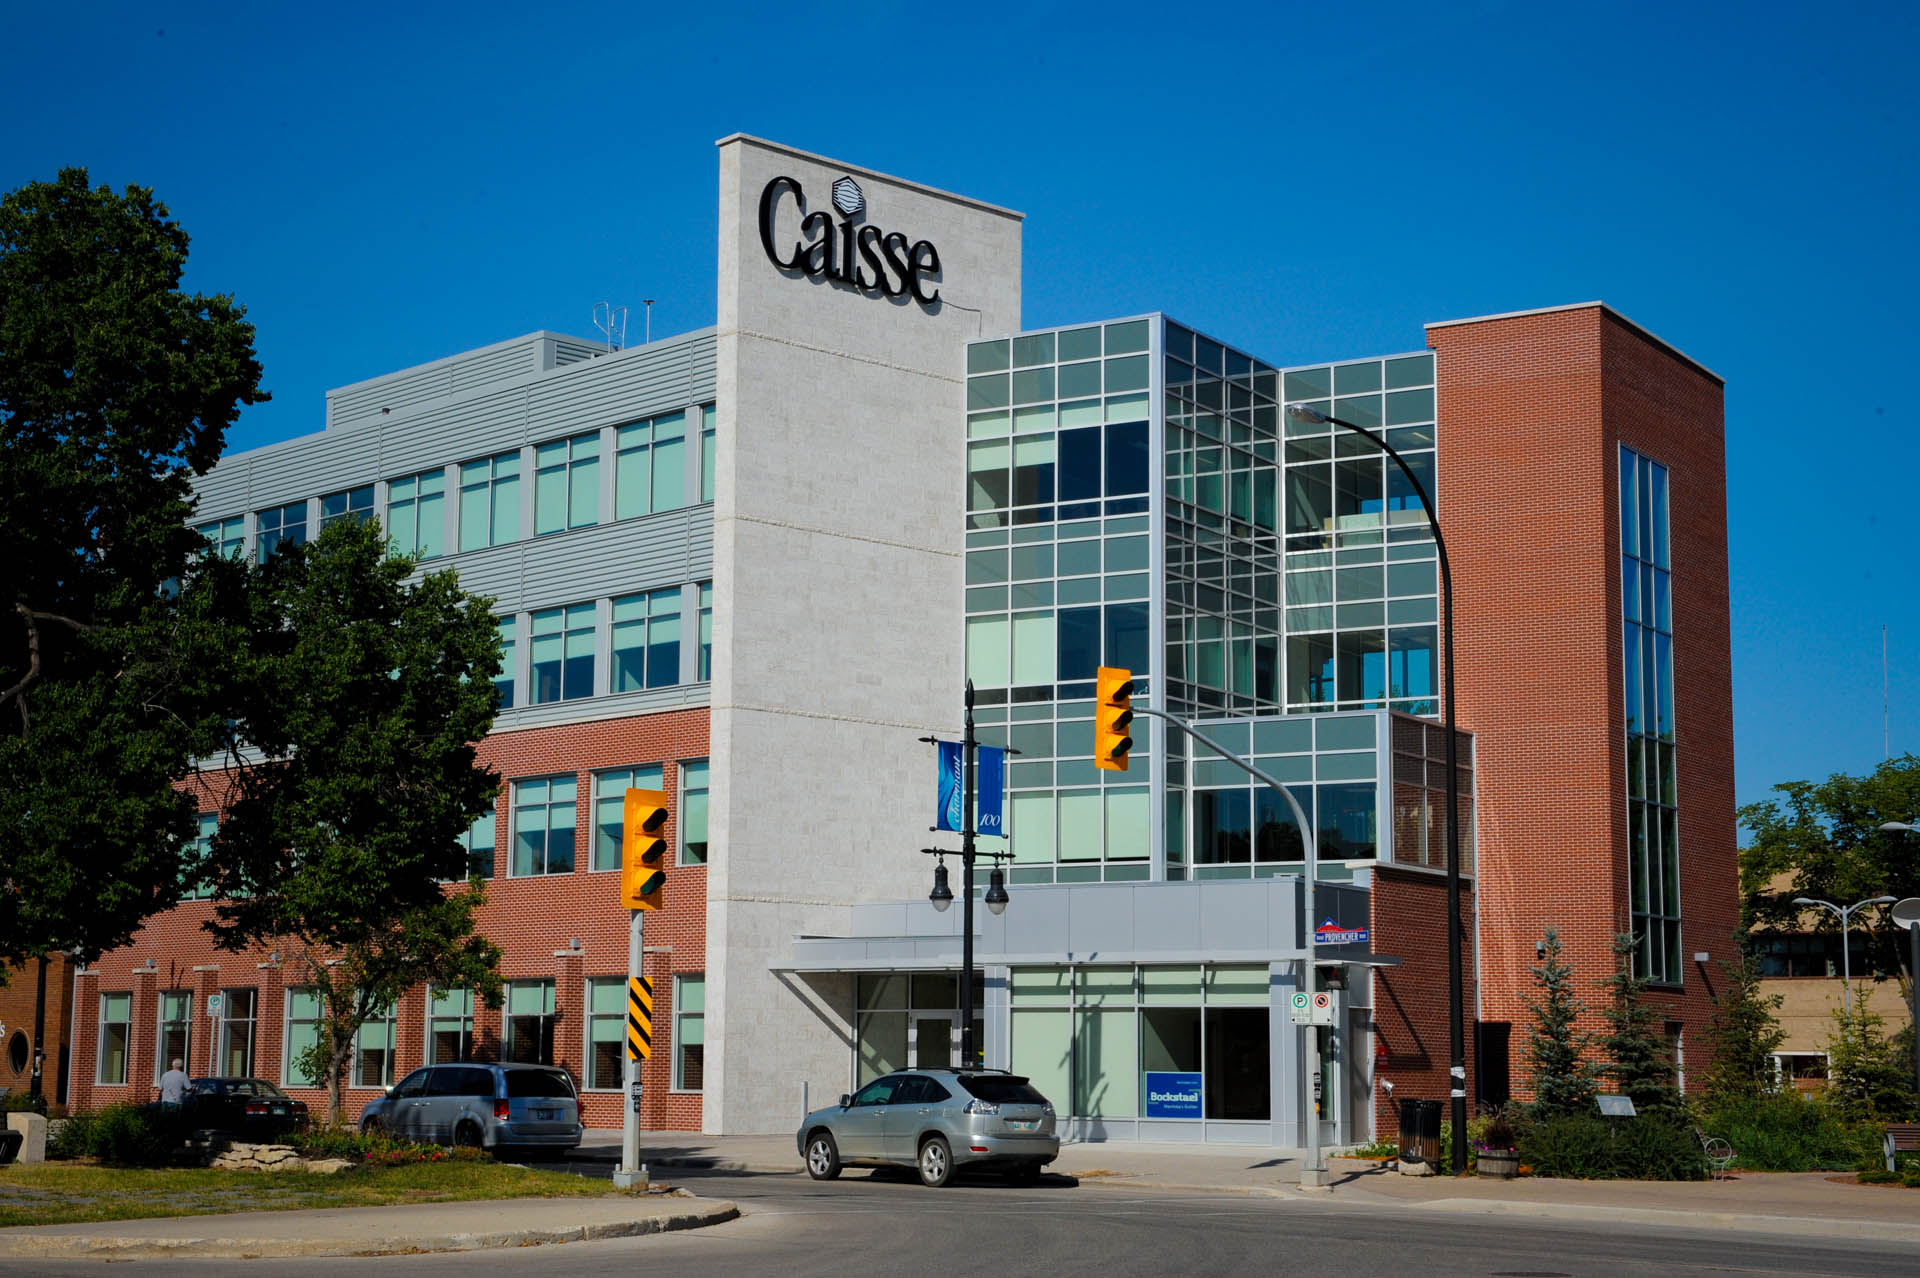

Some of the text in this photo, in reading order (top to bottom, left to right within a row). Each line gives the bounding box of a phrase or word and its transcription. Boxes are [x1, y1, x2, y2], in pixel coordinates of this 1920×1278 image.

[758, 175, 940, 304] Caisse
[979, 813, 1001, 827] 100
[1325, 932, 1358, 942] PROVENCHER
